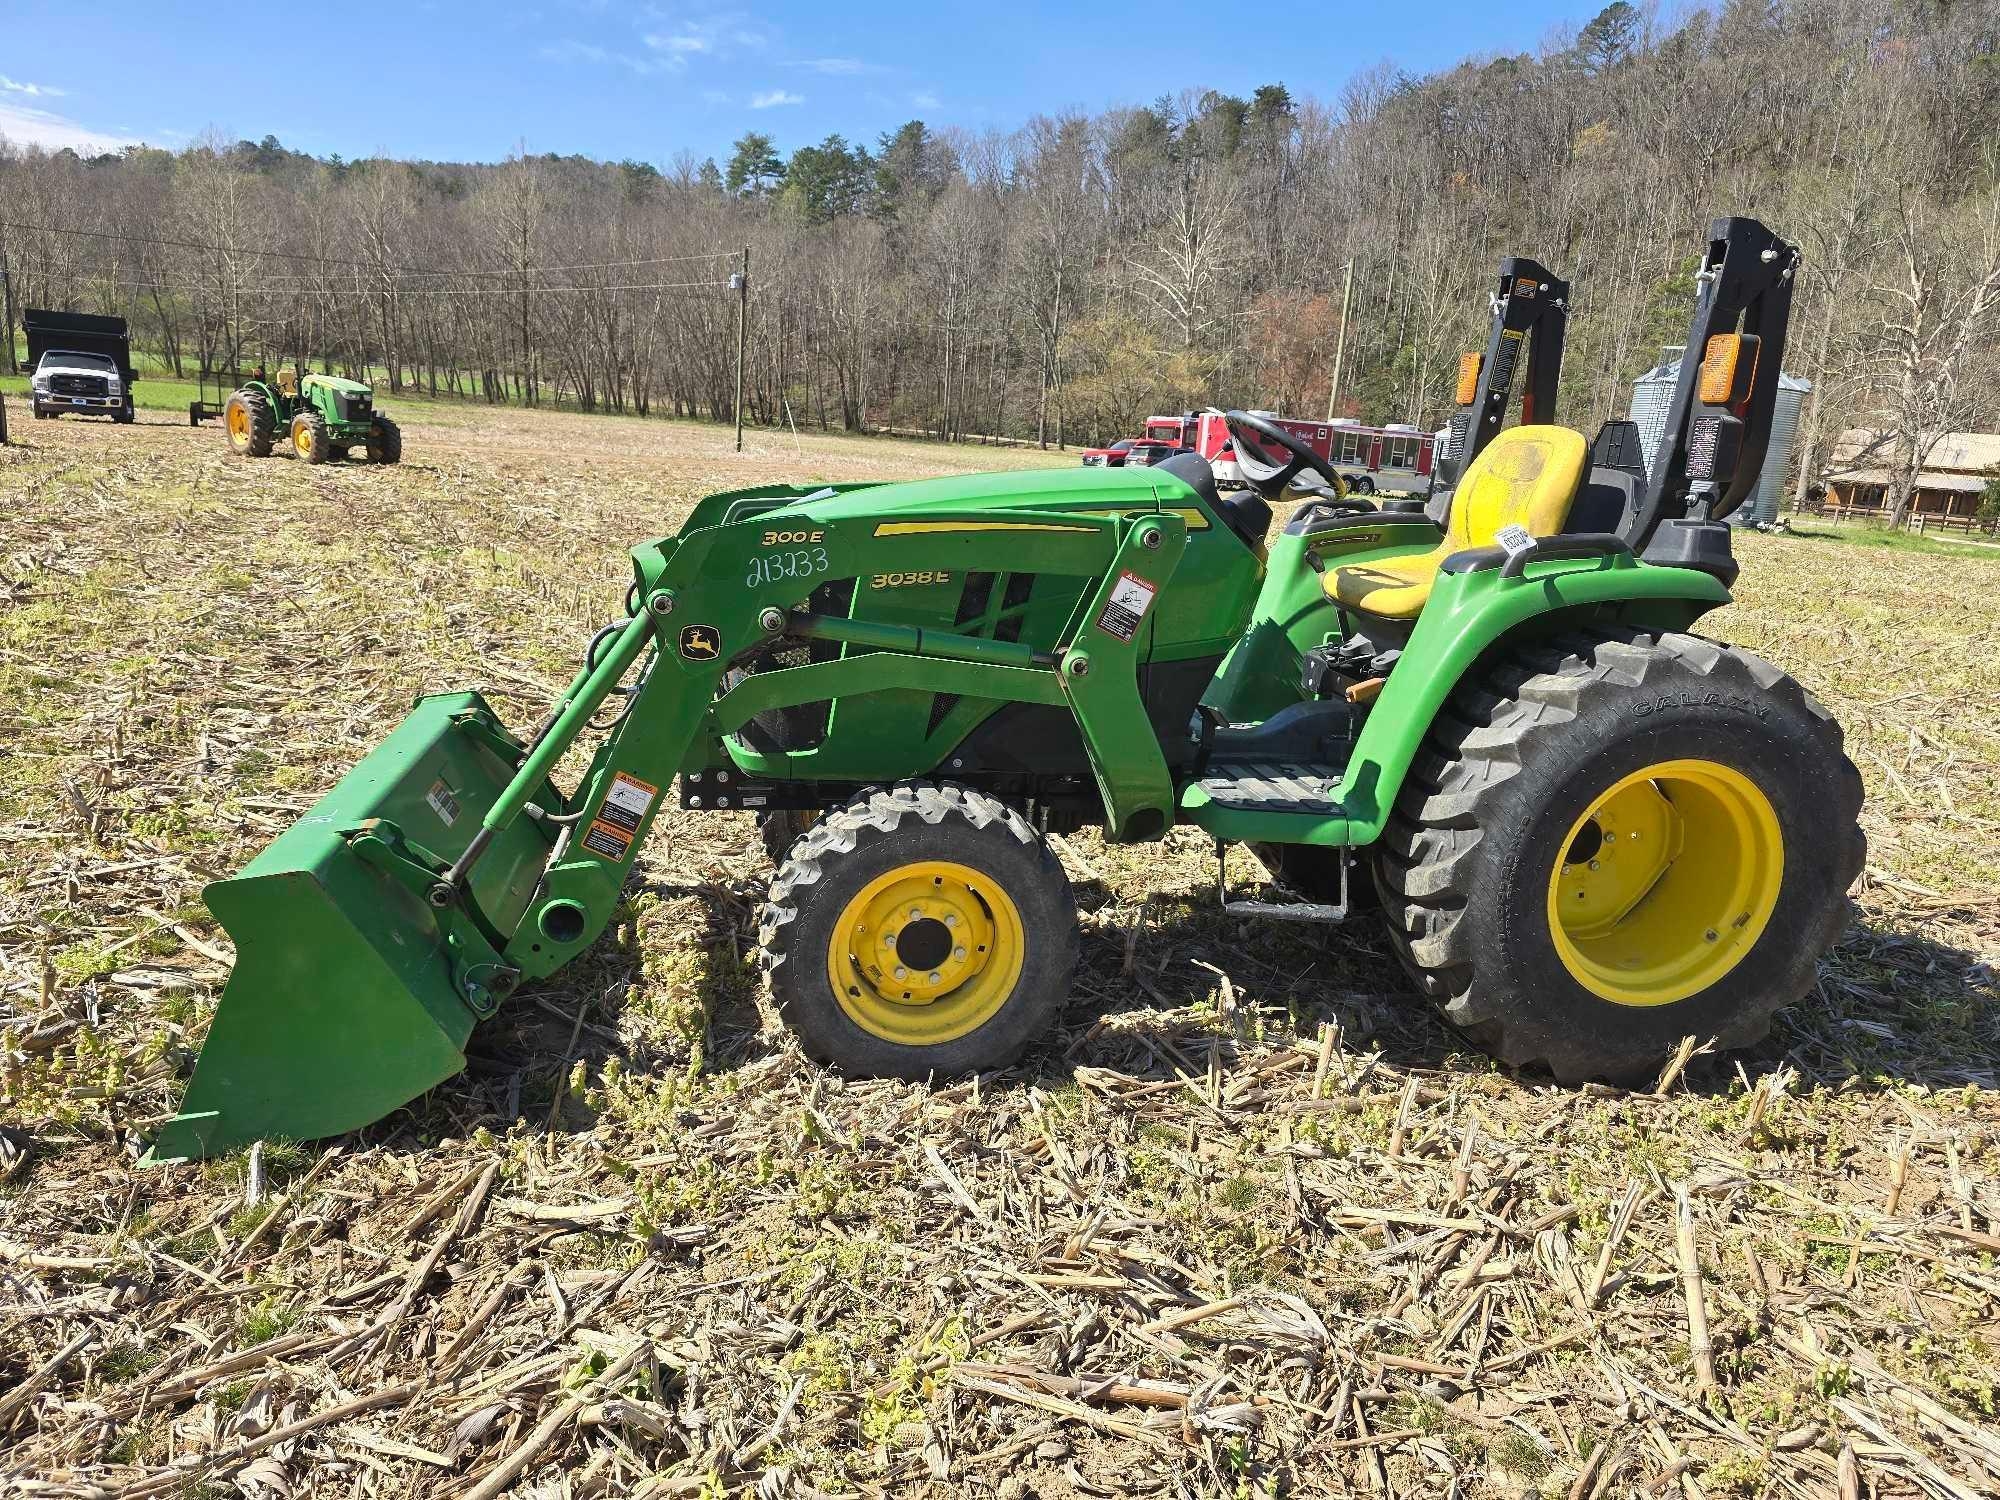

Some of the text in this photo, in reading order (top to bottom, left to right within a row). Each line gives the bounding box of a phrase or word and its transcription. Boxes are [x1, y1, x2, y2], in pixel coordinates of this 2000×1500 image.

[746, 547, 829, 588] 213233
[1632, 692, 1770, 717] GALAXY
[627, 776, 653, 791] WARNING
[603, 826, 629, 841] WARNING
